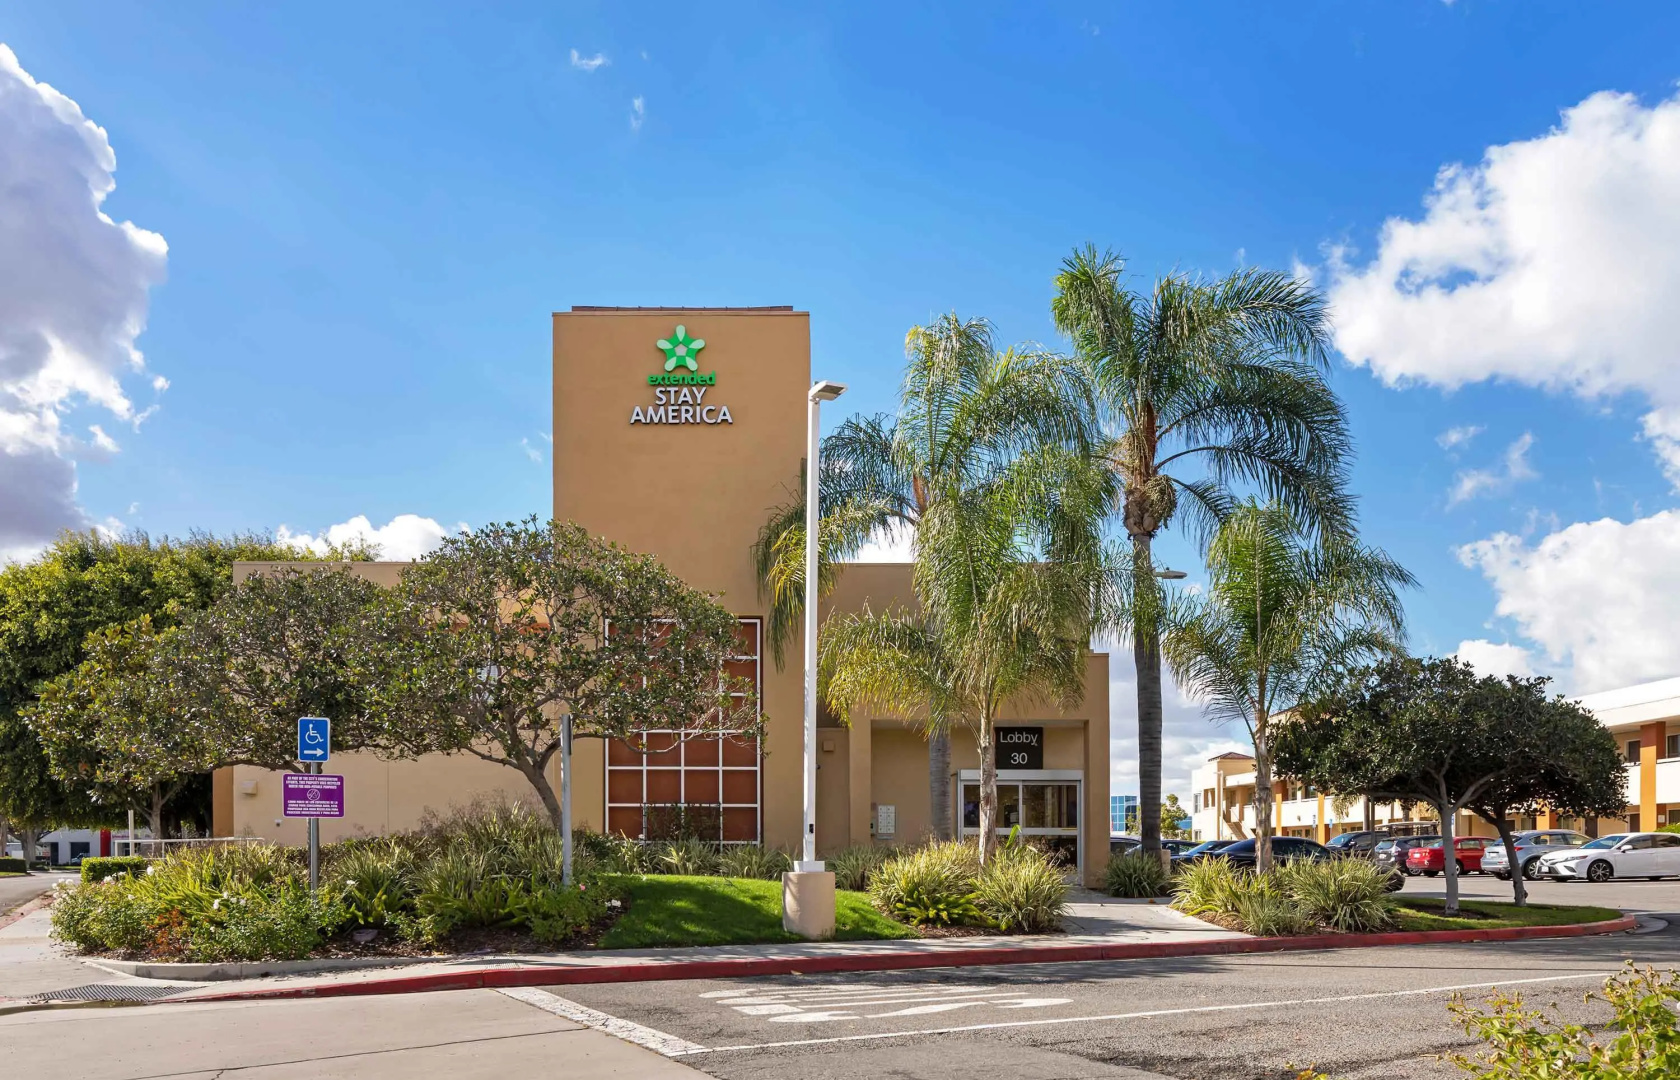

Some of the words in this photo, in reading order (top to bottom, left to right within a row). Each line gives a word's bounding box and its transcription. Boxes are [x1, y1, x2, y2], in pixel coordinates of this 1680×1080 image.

[647, 370, 716, 385] extended
[655, 387, 707, 405] STAY
[630, 405, 733, 424] AMERICA
[1000, 731, 1038, 746] Lobby
[1010, 752, 1028, 765] 30
[698, 983, 1074, 1023] STOP
